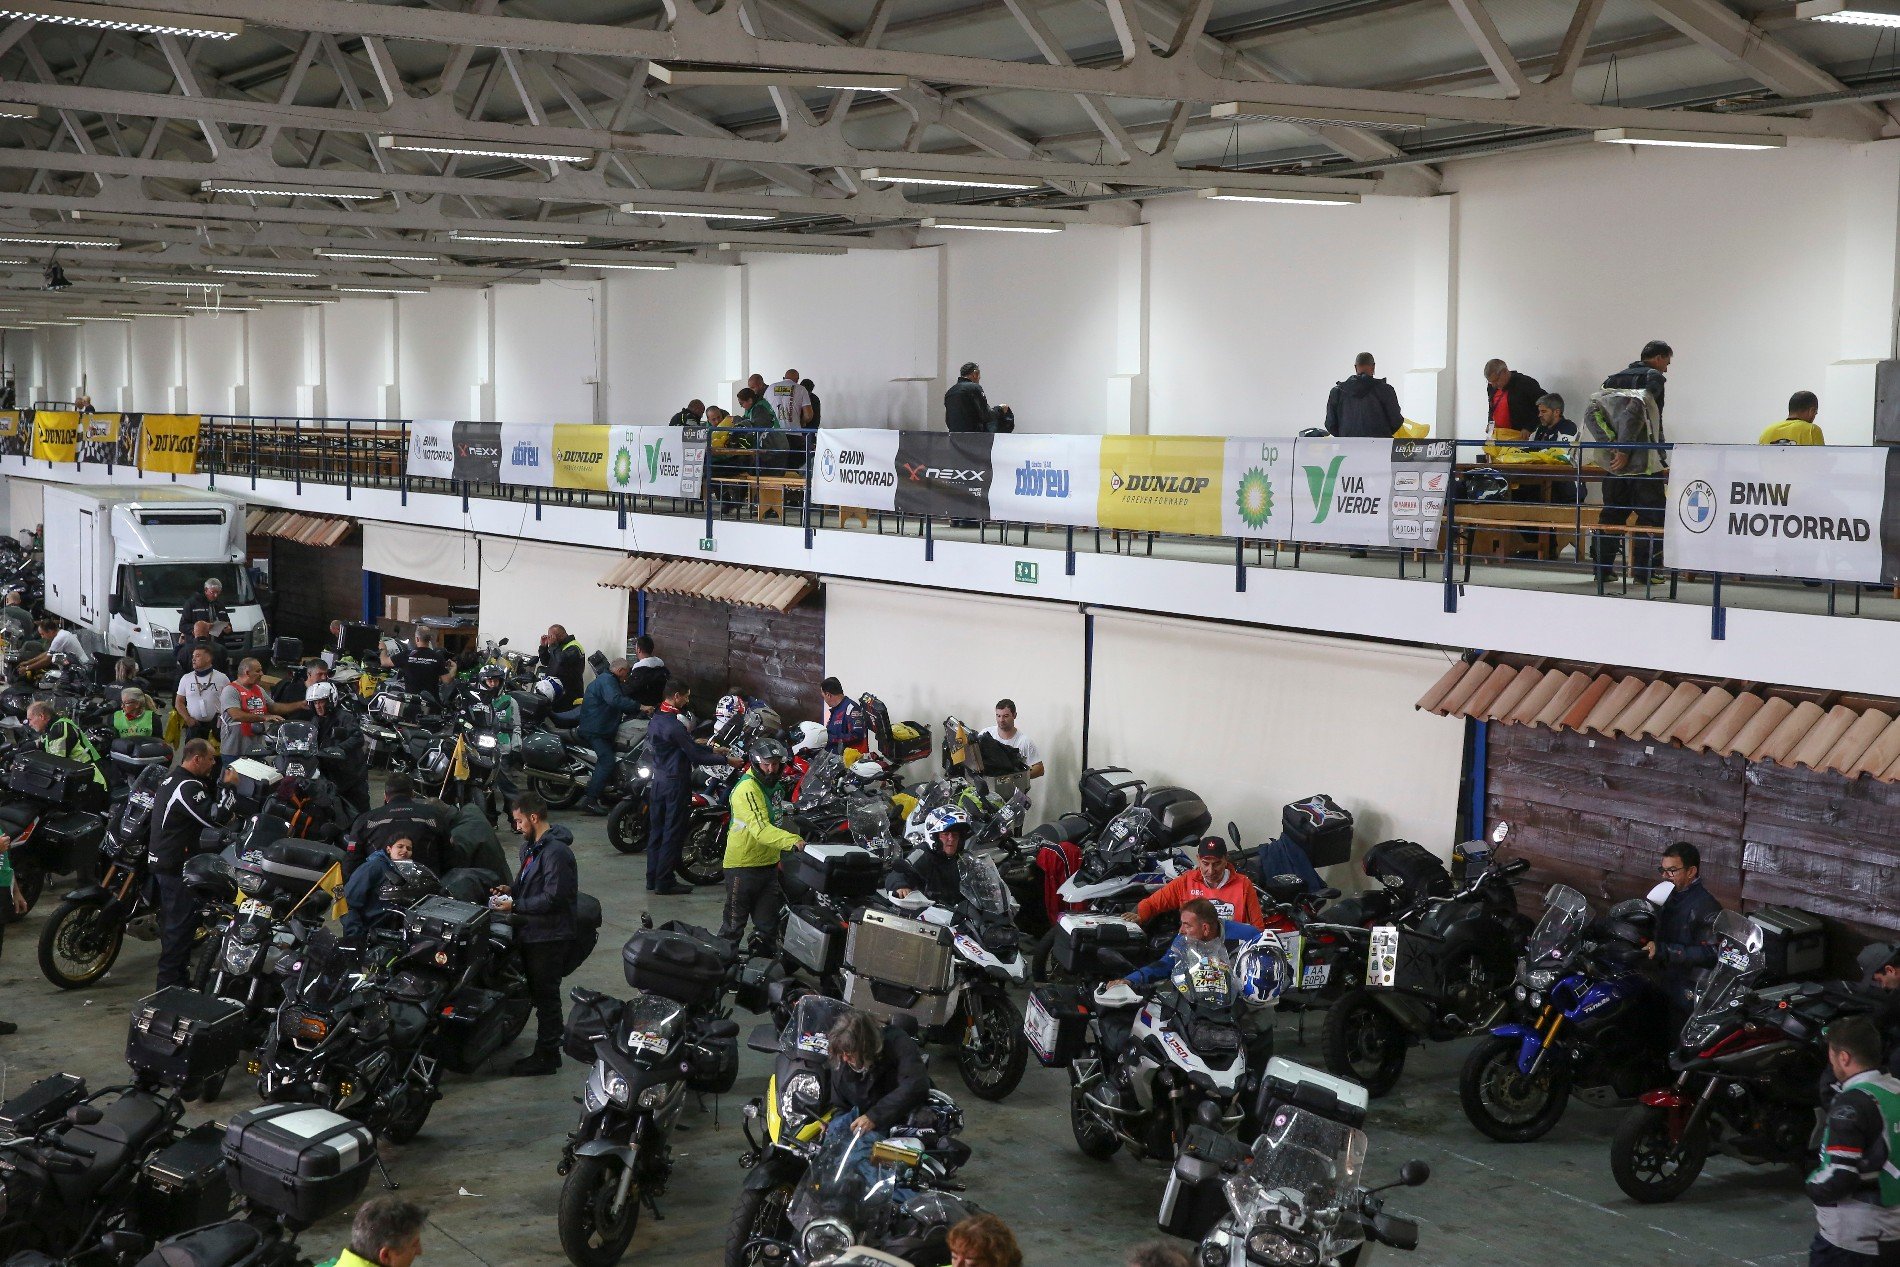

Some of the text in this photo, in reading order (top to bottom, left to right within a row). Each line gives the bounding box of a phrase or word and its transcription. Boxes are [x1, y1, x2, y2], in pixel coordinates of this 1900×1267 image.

[44, 428, 77, 445] DUNLOP
[625, 429, 634, 445] bp
[563, 450, 603, 464] DUNLOP
[660, 451, 672, 463] VIA
[839, 450, 865, 466] BMW
[1261, 442, 1278, 466] bp
[660, 464, 680, 477] VERDE
[839, 468, 895, 487] MOTORRAD
[1014, 460, 1070, 498] abreu
[1125, 474, 1209, 494] DUNLOP
[1341, 476, 1365, 493] VIA
[1121, 495, 1189, 506] FOREVER FORWARD
[1730, 481, 1791, 507] BMW
[1337, 495, 1381, 515] VERDE
[1728, 512, 1871, 542] MOTORRAD
[1311, 965, 1323, 975] AA
